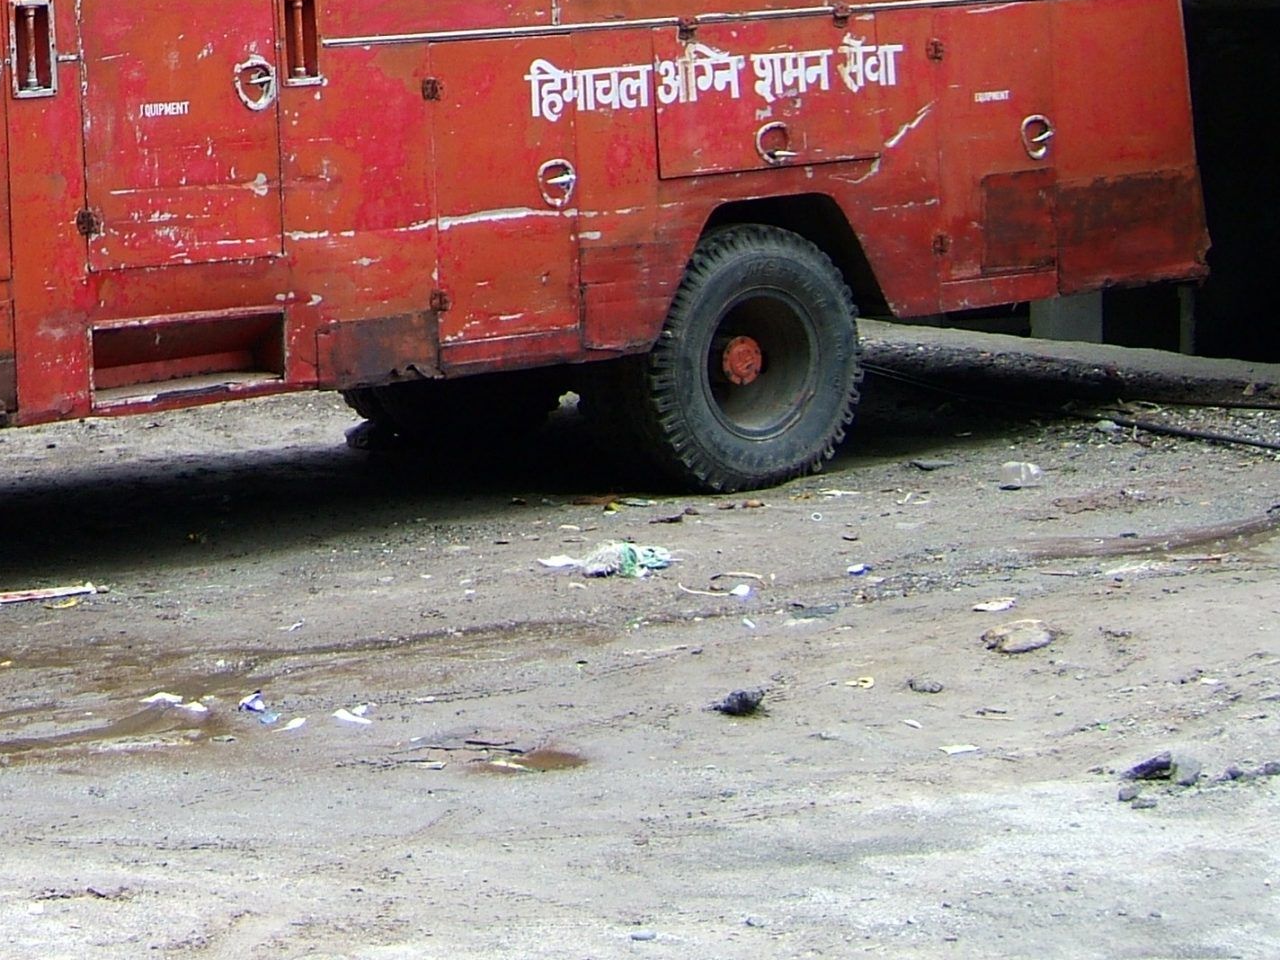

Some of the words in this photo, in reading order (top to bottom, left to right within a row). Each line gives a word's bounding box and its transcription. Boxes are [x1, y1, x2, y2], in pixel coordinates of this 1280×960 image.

[524, 58, 651, 122] हिमाचल
[657, 42, 745, 104] अग्नि
[750, 49, 833, 103] शमन
[838, 33, 903, 92] सेवा
